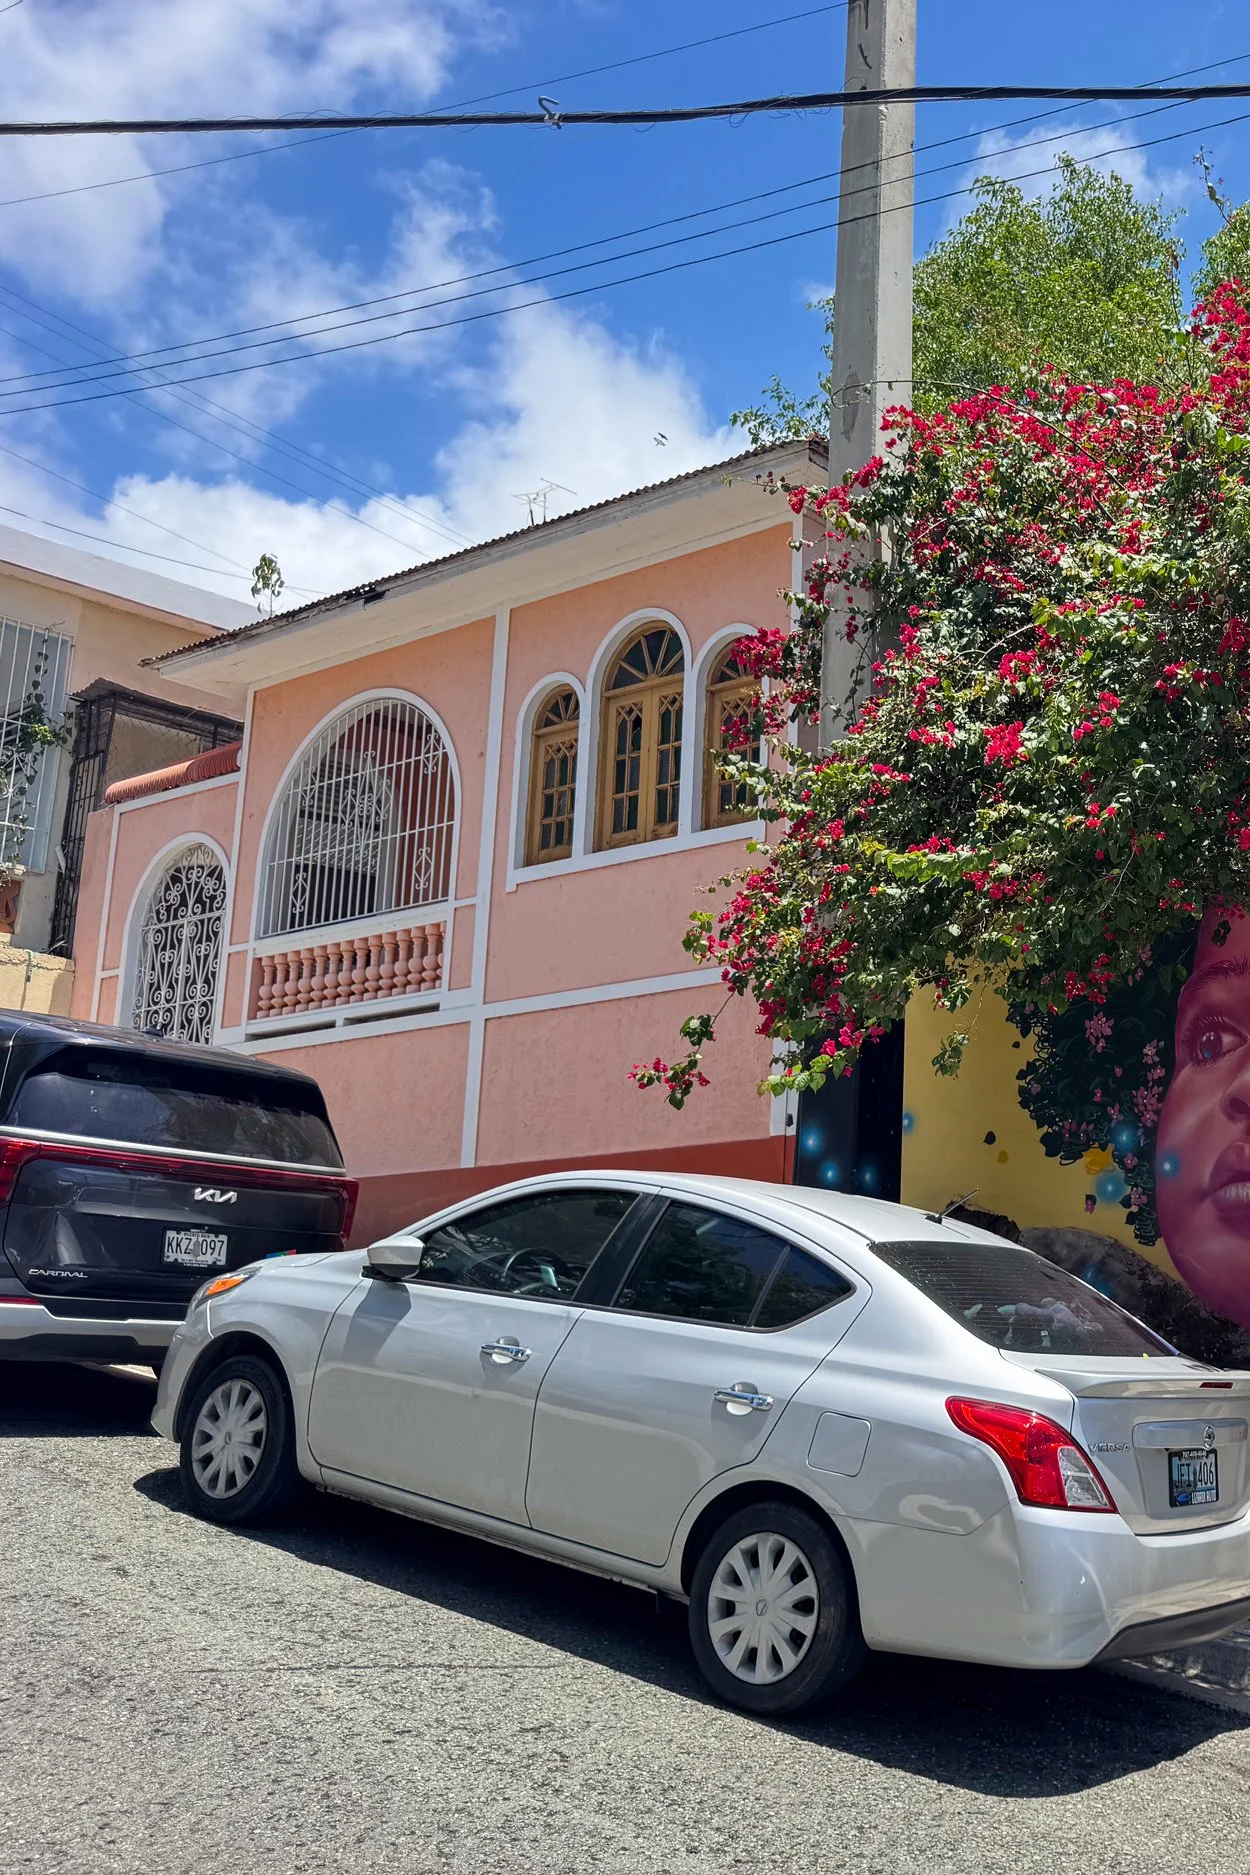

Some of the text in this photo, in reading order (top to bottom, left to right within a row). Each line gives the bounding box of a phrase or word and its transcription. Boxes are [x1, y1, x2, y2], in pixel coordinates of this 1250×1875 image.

[167, 1237, 224, 1257] KKZ 097
[28, 1268, 88, 1278] CARNIVAL
[1088, 1443, 1132, 1453] VERSA
[1174, 1462, 1214, 1488] JFI 406
